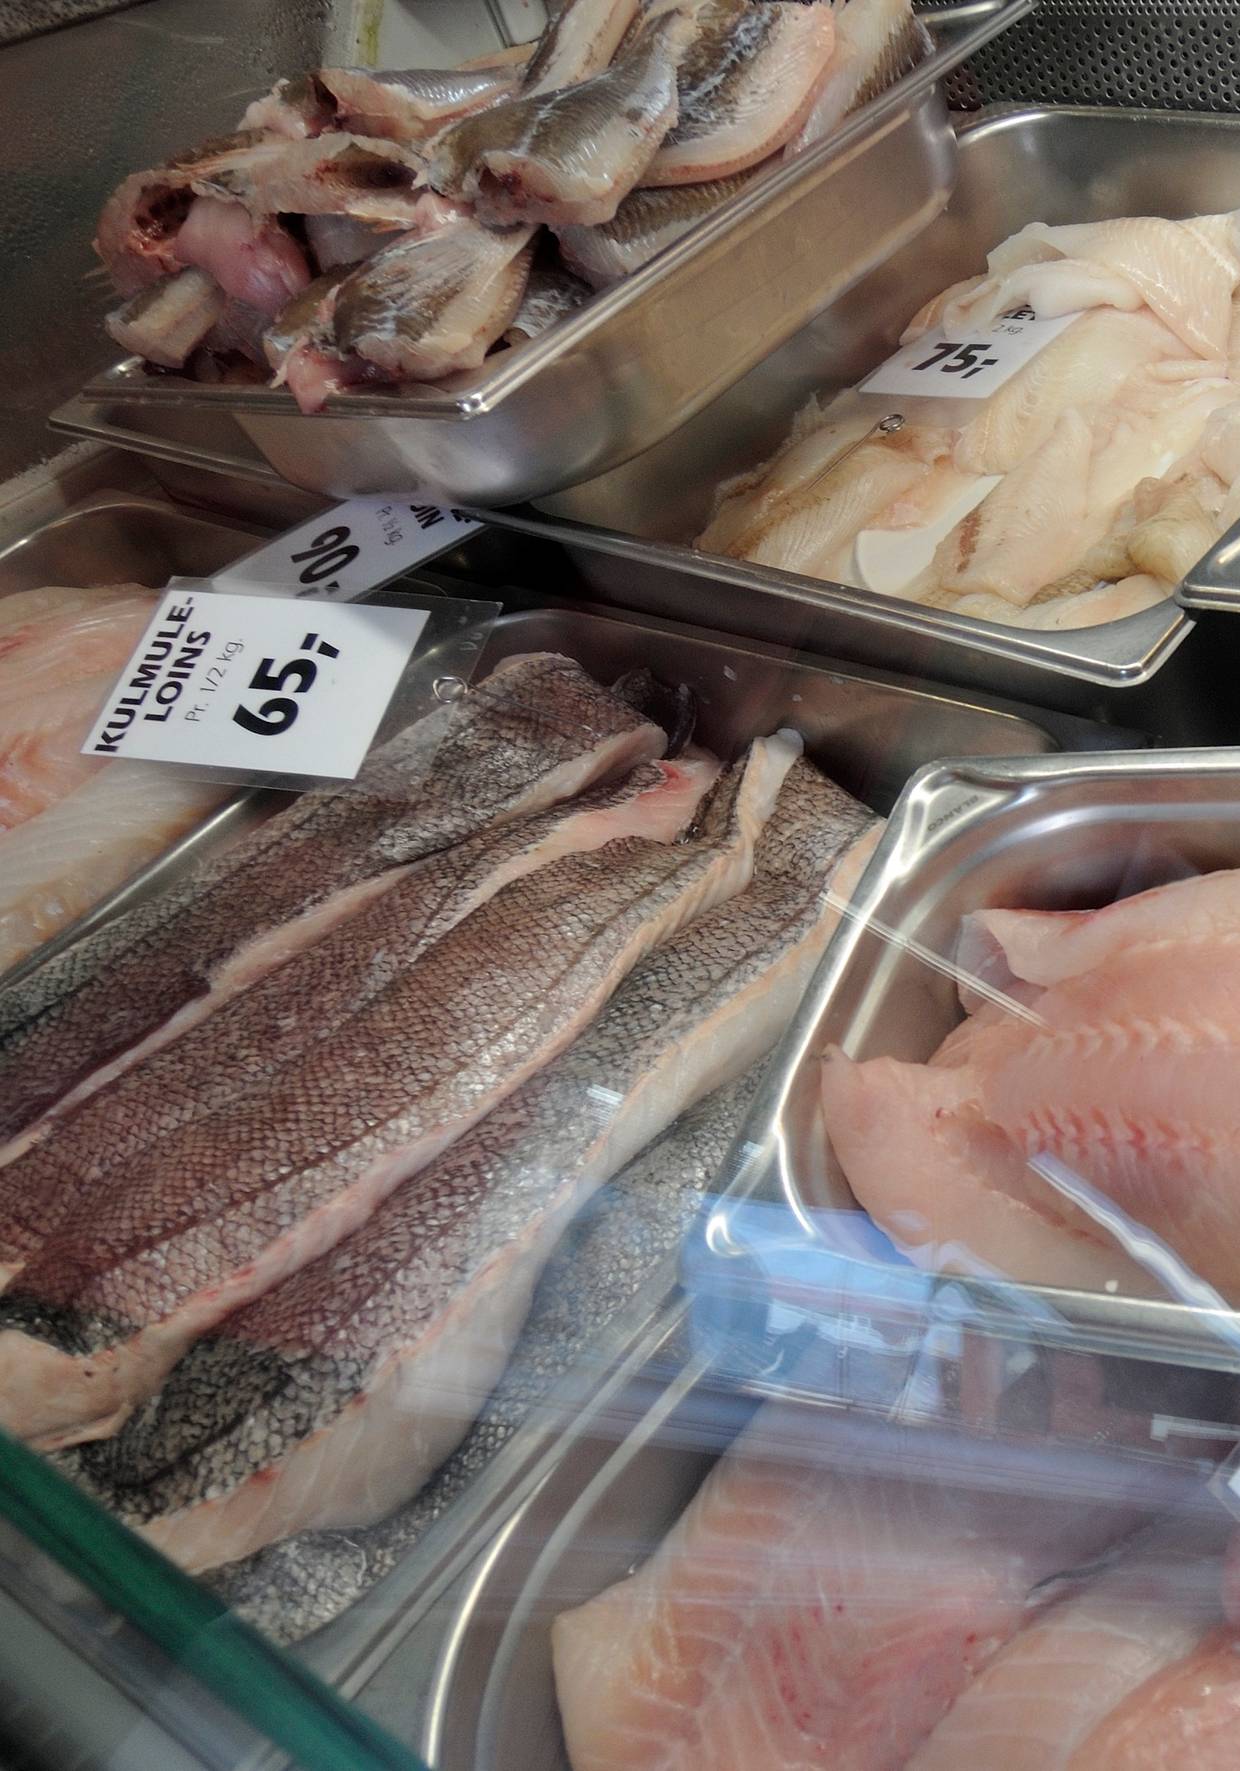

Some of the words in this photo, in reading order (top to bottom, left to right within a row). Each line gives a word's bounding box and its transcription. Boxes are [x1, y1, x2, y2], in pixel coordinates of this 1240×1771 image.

[912, 342, 999, 379] 75,-
[94, 597, 194, 753] KULMULE-
[144, 631, 211, 722] LOINS
[184, 703, 209, 722] Pr.
[200, 666, 226, 692] 1/2
[232, 632, 341, 737] 65,-
